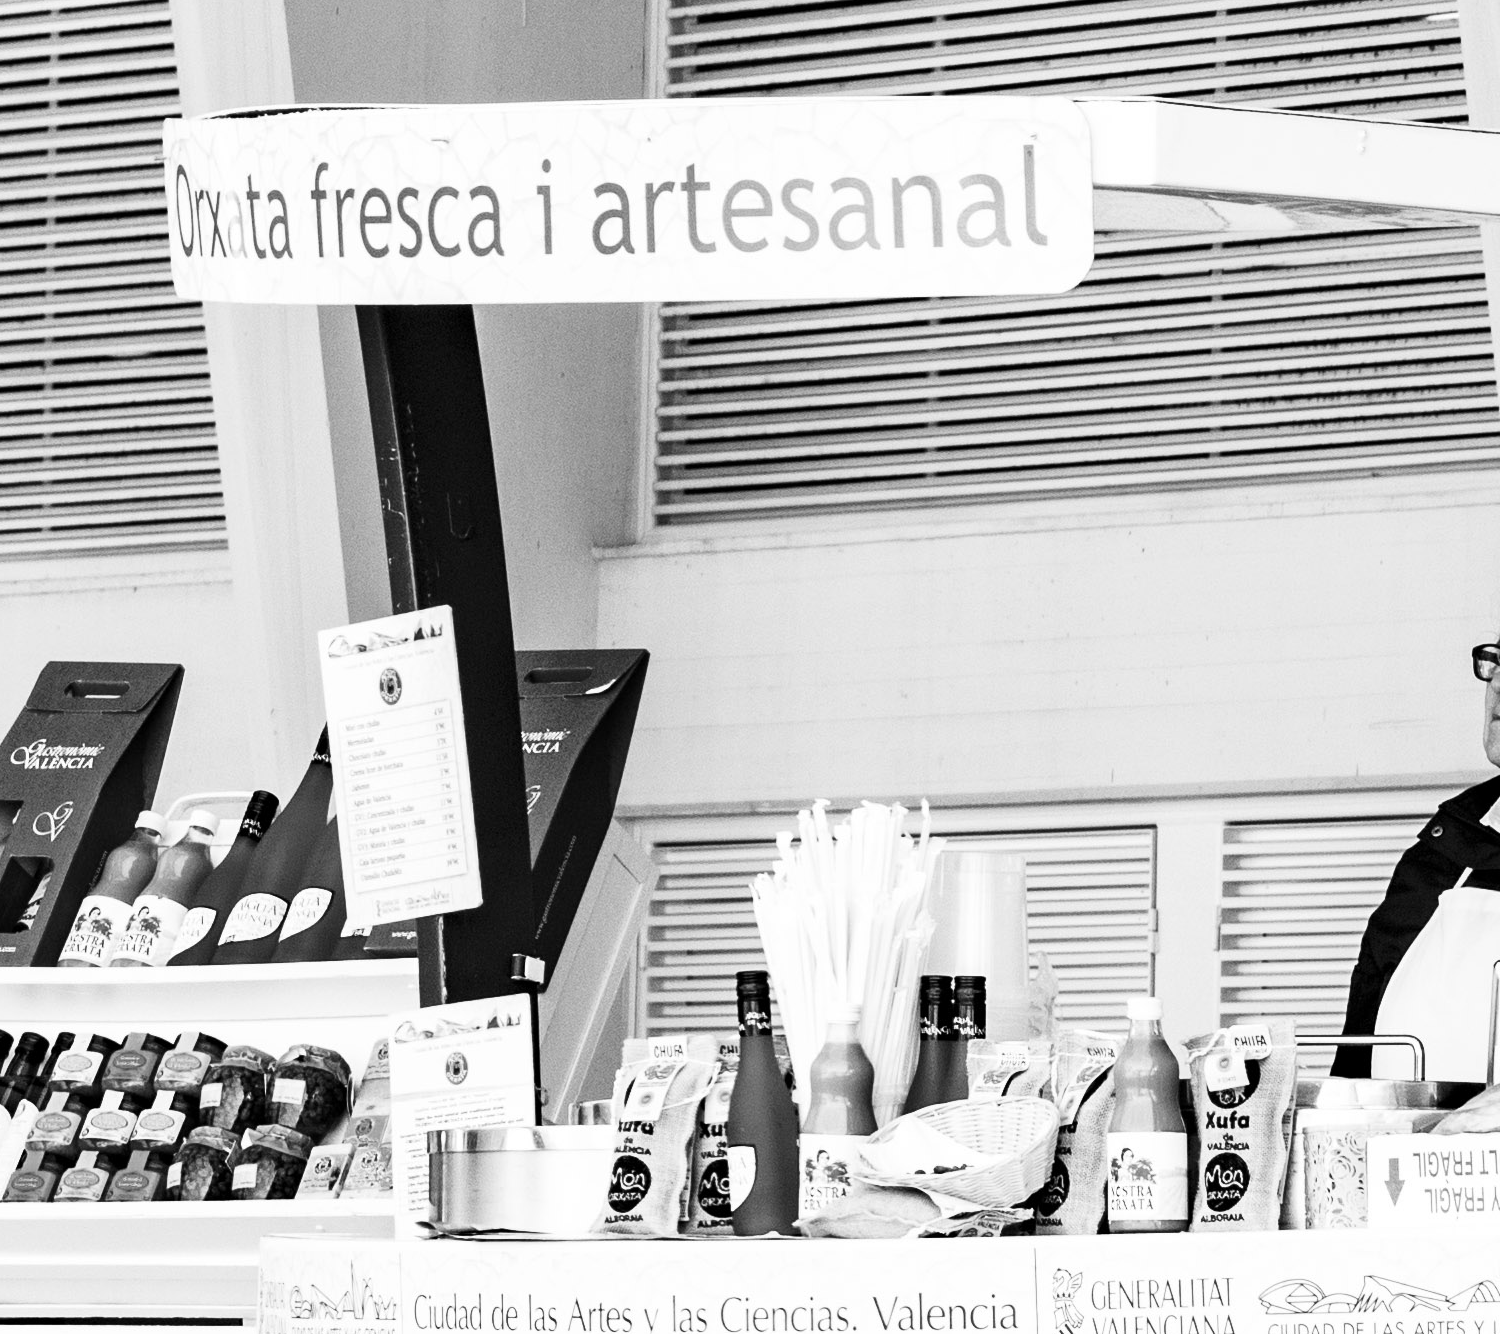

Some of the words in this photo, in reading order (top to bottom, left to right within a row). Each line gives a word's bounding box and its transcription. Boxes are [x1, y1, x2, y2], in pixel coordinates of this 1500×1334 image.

[176, 163, 293, 259] Orxata
[311, 161, 506, 259] fresca
[536, 158, 554, 255] i
[592, 144, 1049, 256] artesanal
[522, 742, 560, 754] NCIA
[653, 1044, 685, 1059] CHUFA
[1233, 1033, 1268, 1047] CHUFA
[1206, 1110, 1251, 1130] Xufa
[611, 1167, 646, 1191] Món
[1205, 1164, 1244, 1189] Món
[1090, 1276, 1235, 1311] GENERALITAT
[413, 1293, 483, 1332] Ciudad
[491, 1293, 519, 1332] de
[528, 1294, 558, 1332] las
[567, 1298, 633, 1334] Artes
[672, 1295, 708, 1334] las
[720, 1296, 858, 1334] Ciencias.
[873, 1293, 1019, 1331] Valencia
